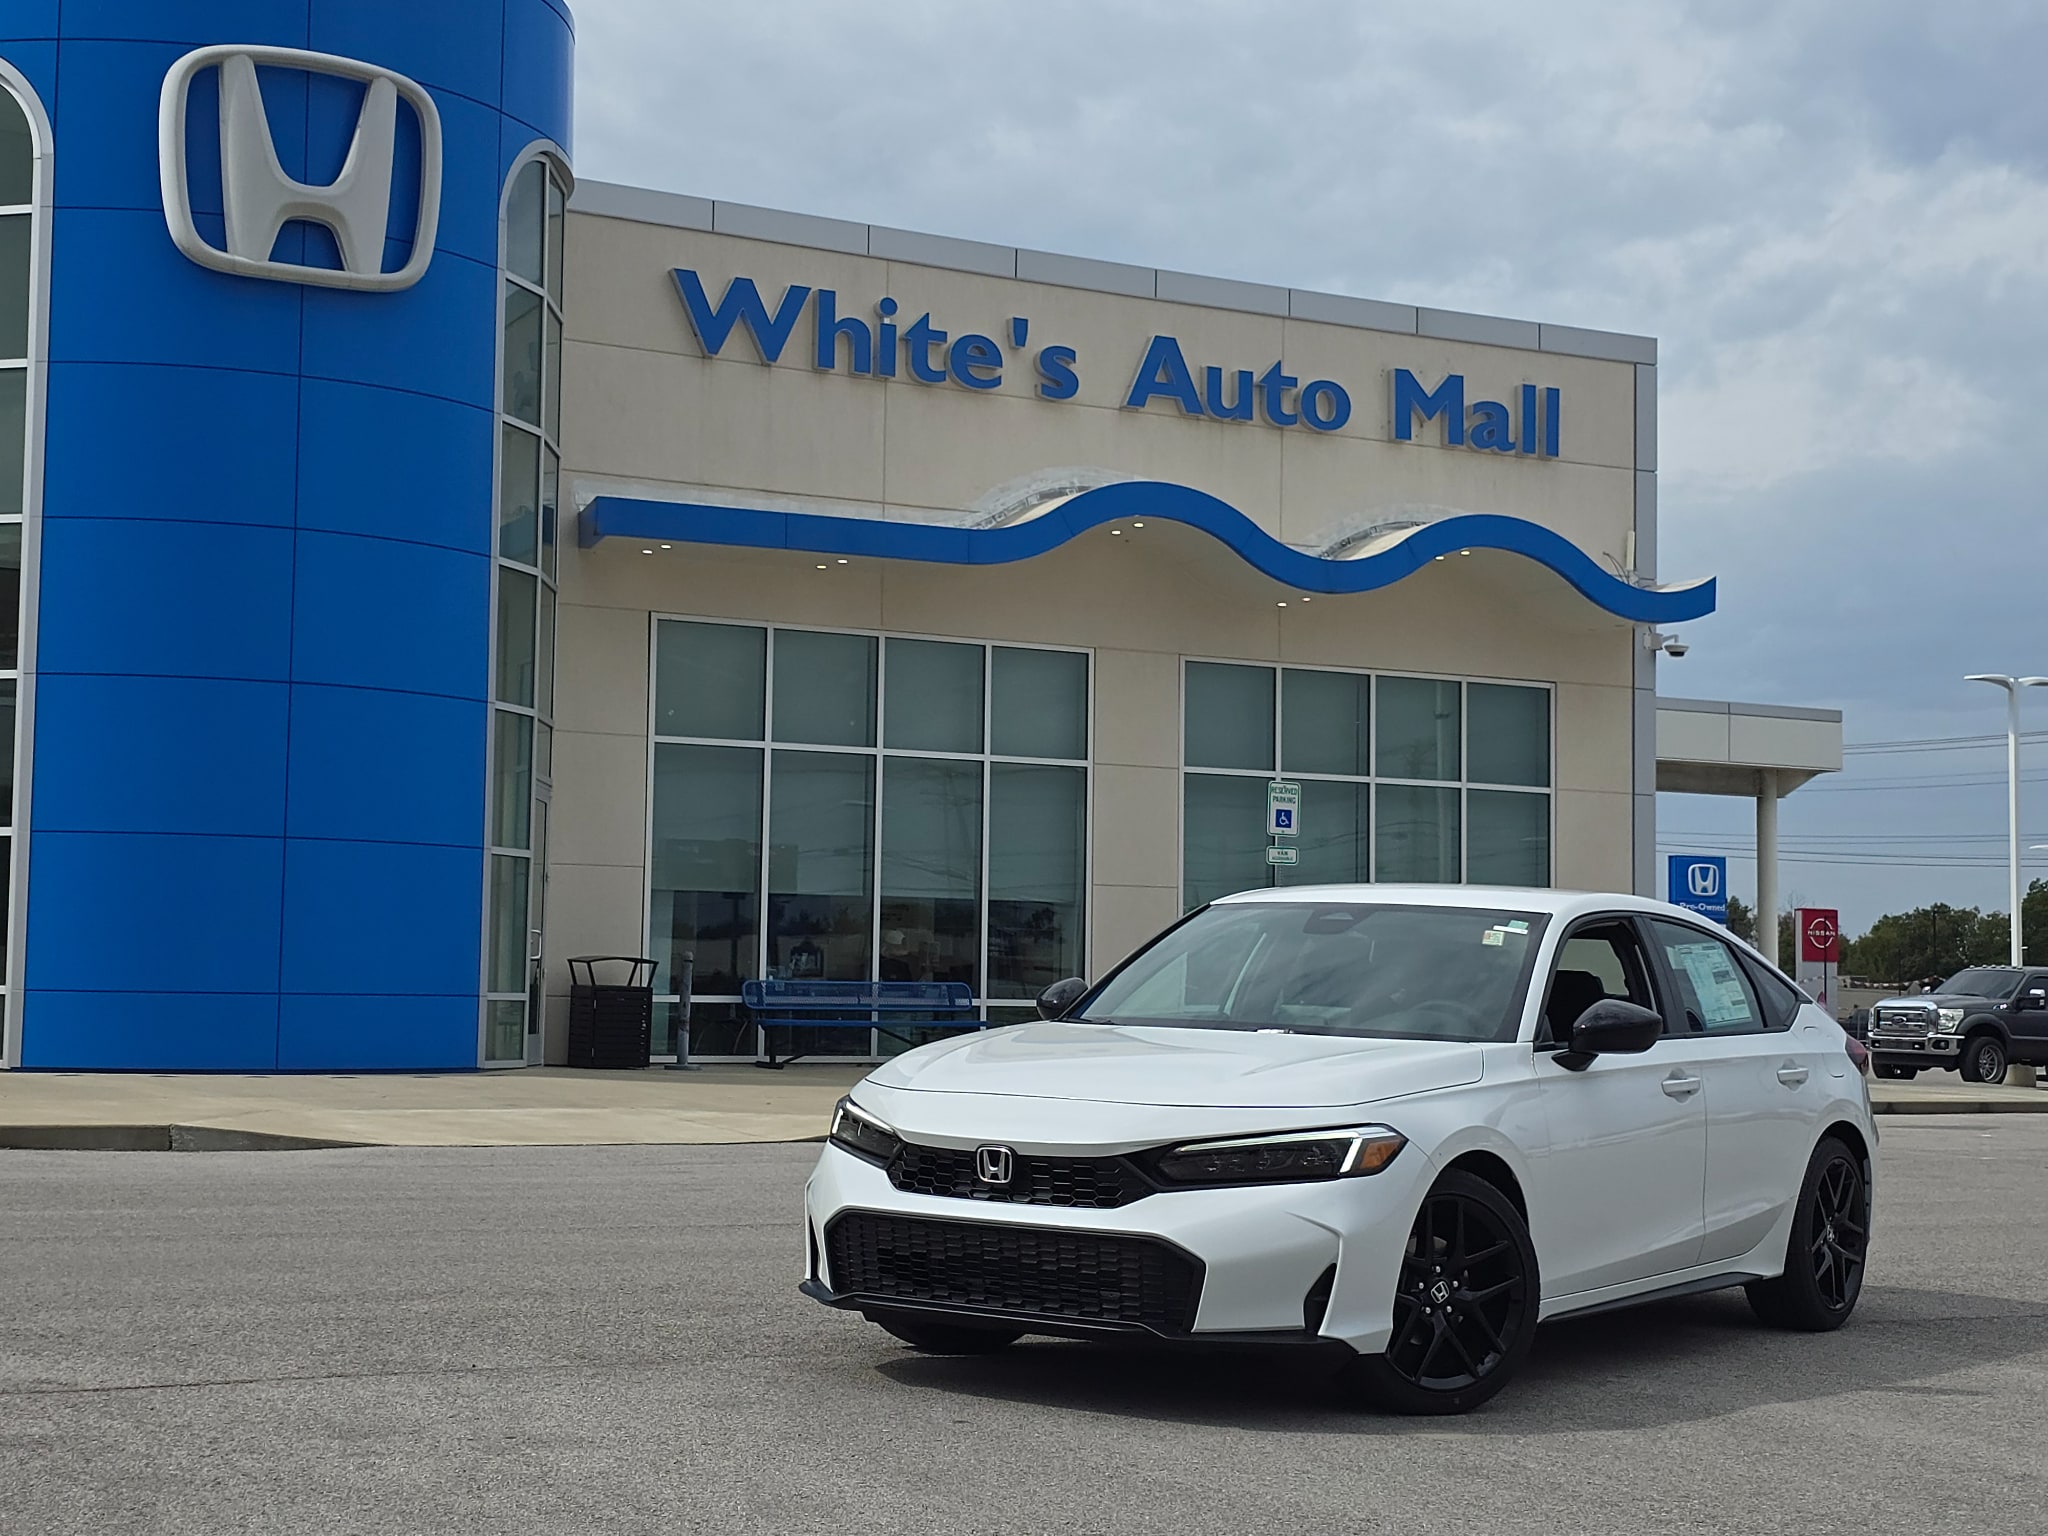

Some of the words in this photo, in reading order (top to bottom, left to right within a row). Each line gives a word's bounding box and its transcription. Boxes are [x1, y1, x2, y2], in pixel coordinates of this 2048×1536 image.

[668, 267, 1080, 401] White's
[1120, 334, 1352, 432] Auto
[1388, 367, 1560, 459] Mall
[1270, 786, 1298, 796] RESERVED
[1272, 795, 1297, 804] PARKING
[1679, 902, 1726, 912] Pre-Owned
